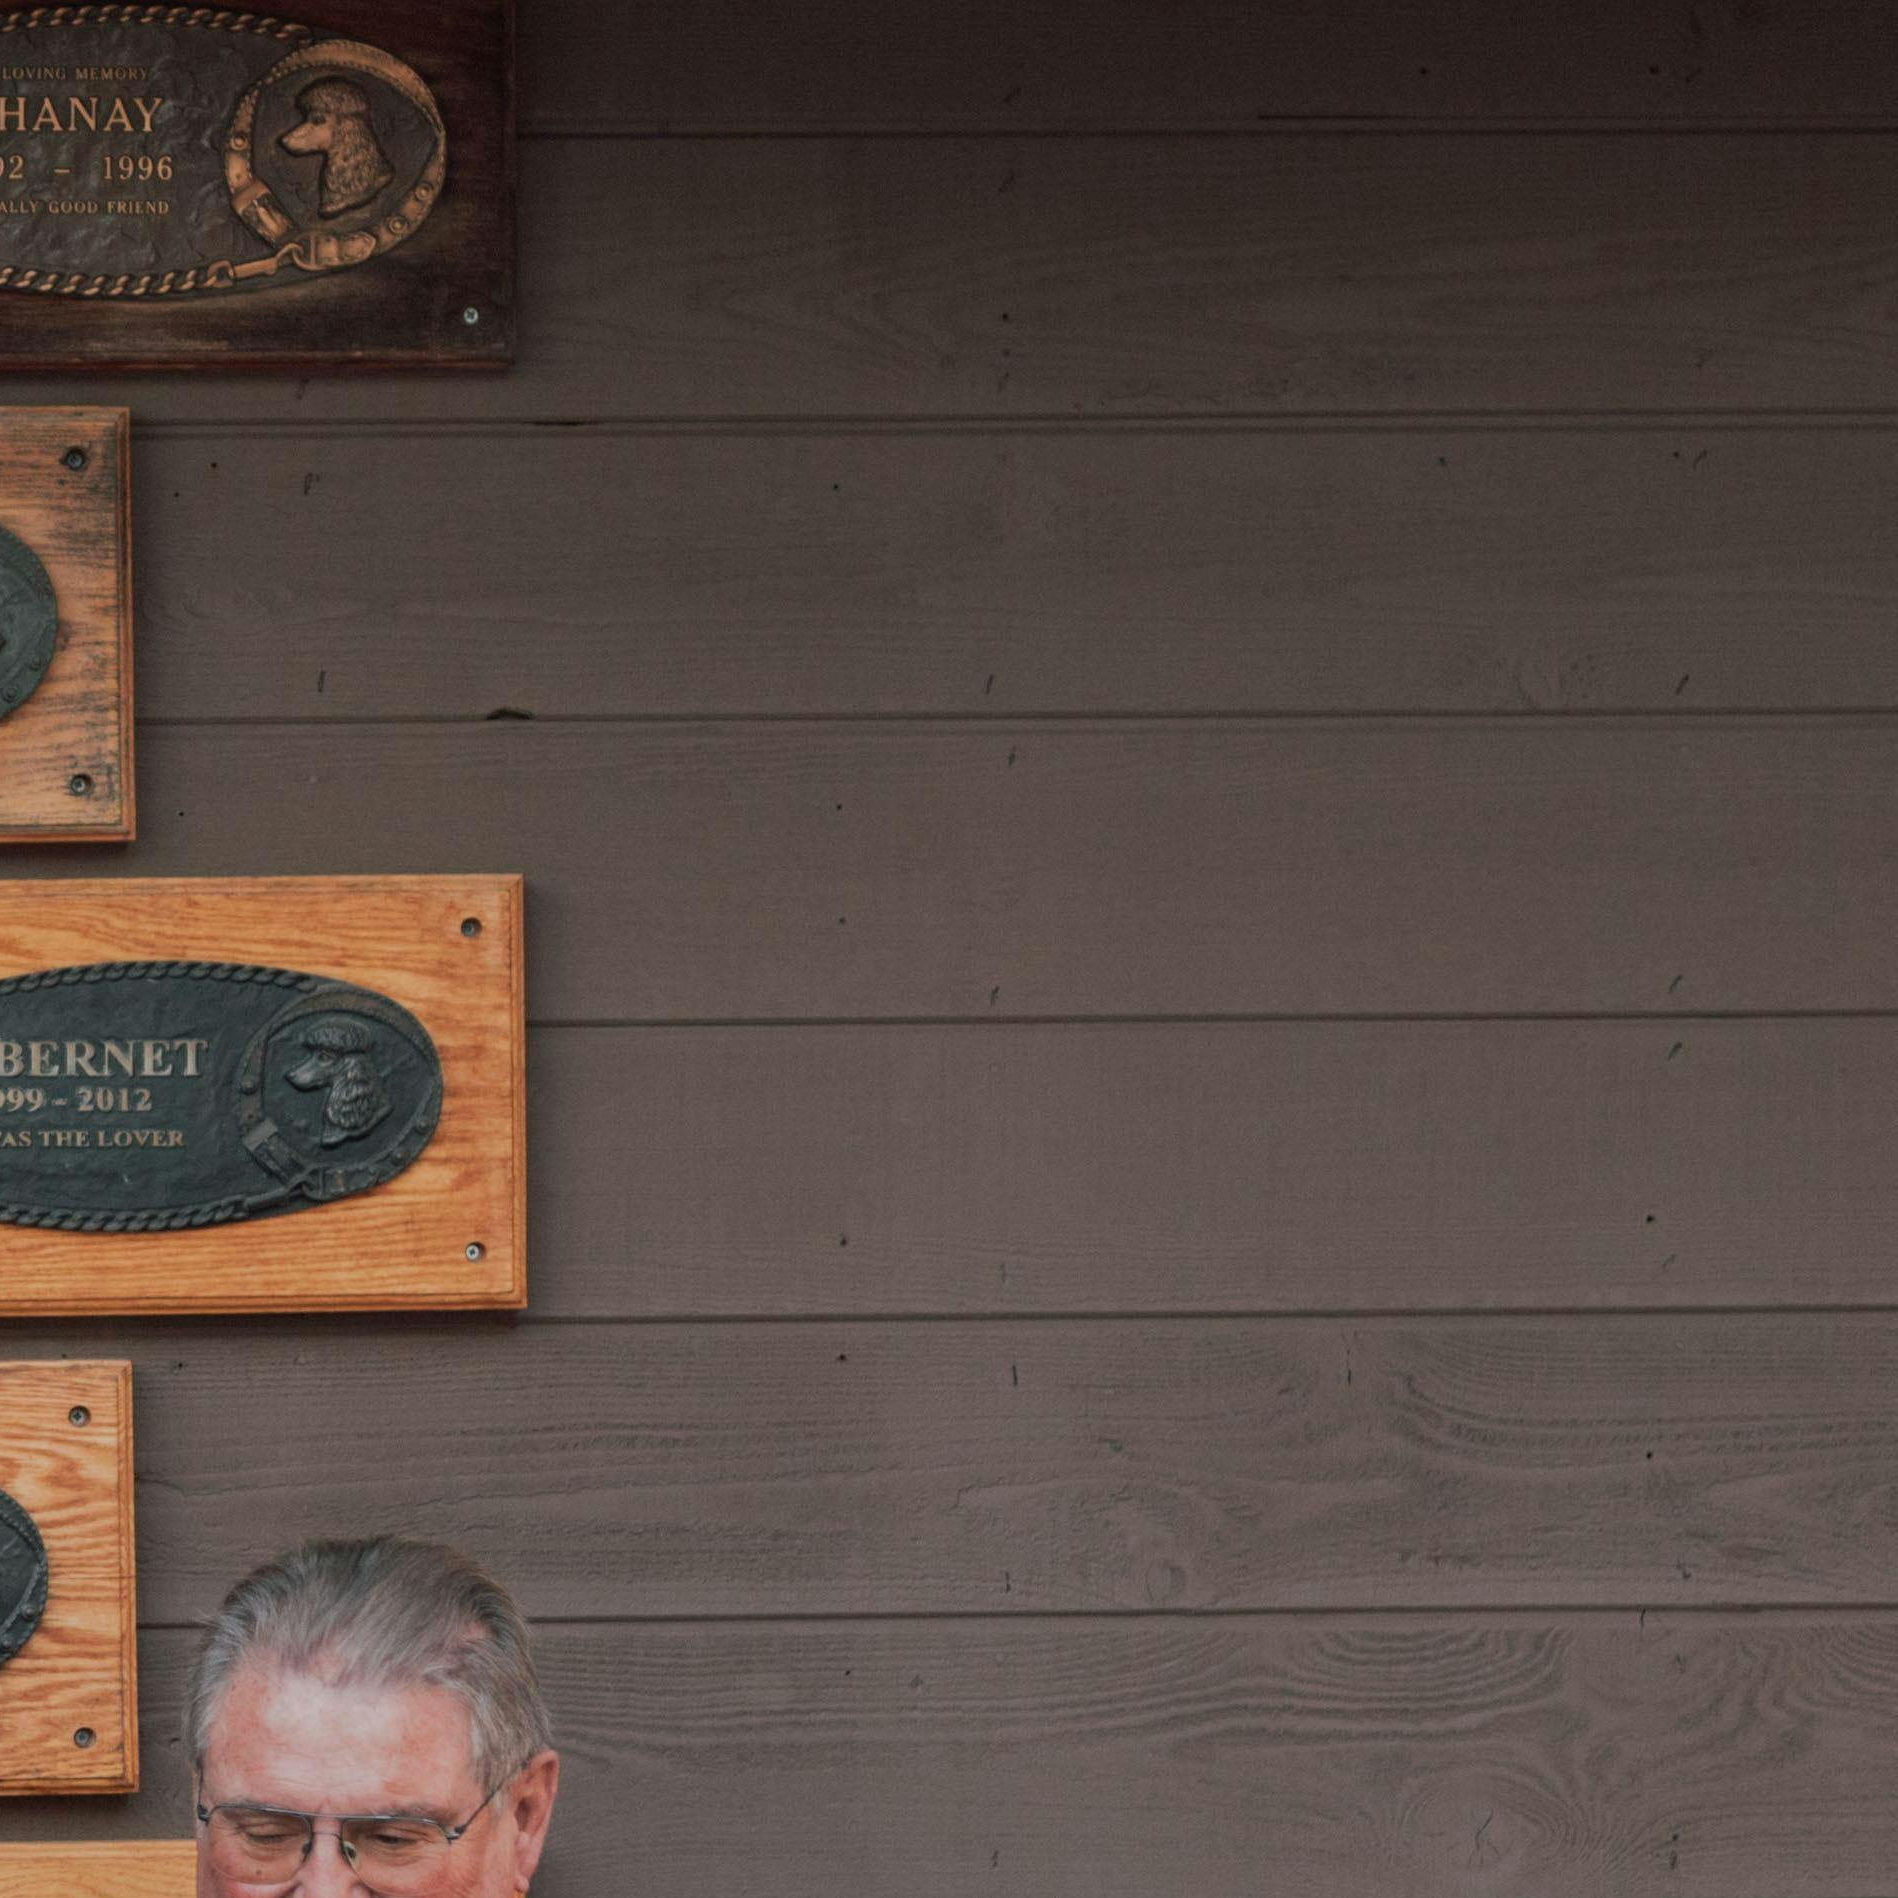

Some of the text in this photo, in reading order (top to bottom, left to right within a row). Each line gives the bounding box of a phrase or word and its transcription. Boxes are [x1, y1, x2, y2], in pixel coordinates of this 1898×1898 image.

[3, 66, 67, 81] LOVING
[75, 67, 149, 81] MEMORY
[103, 155, 173, 181] 1996
[48, 200, 98, 215] GOOD
[107, 200, 170, 215] FRIEND
[76, 1086, 153, 1113] 2012
[38, 1130, 90, 1147] THE
[97, 1129, 187, 1147] LOVER
